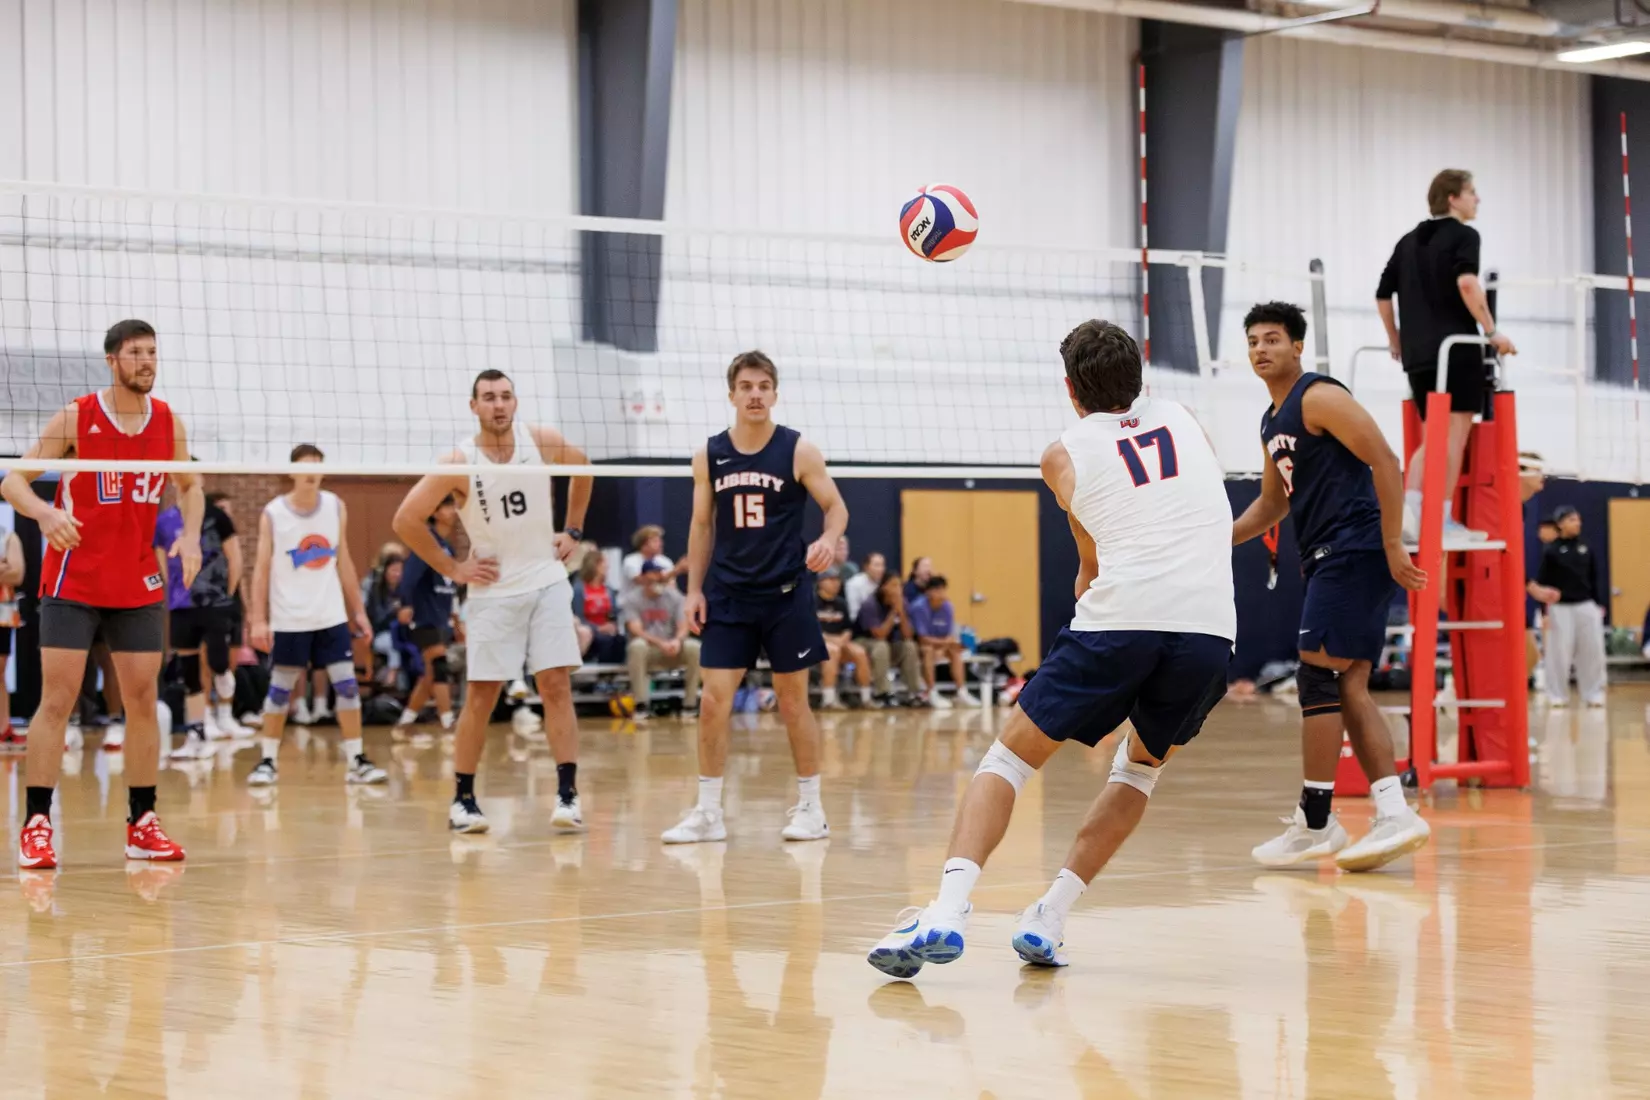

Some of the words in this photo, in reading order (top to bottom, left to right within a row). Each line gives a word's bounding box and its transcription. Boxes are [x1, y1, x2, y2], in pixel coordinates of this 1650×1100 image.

[910, 216, 932, 241] NCAA
[1116, 424, 1179, 488] 17
[132, 471, 166, 505] 32
[714, 471, 785, 493] LIBERTY
[500, 490, 528, 520] 19
[733, 492, 766, 529] 15
